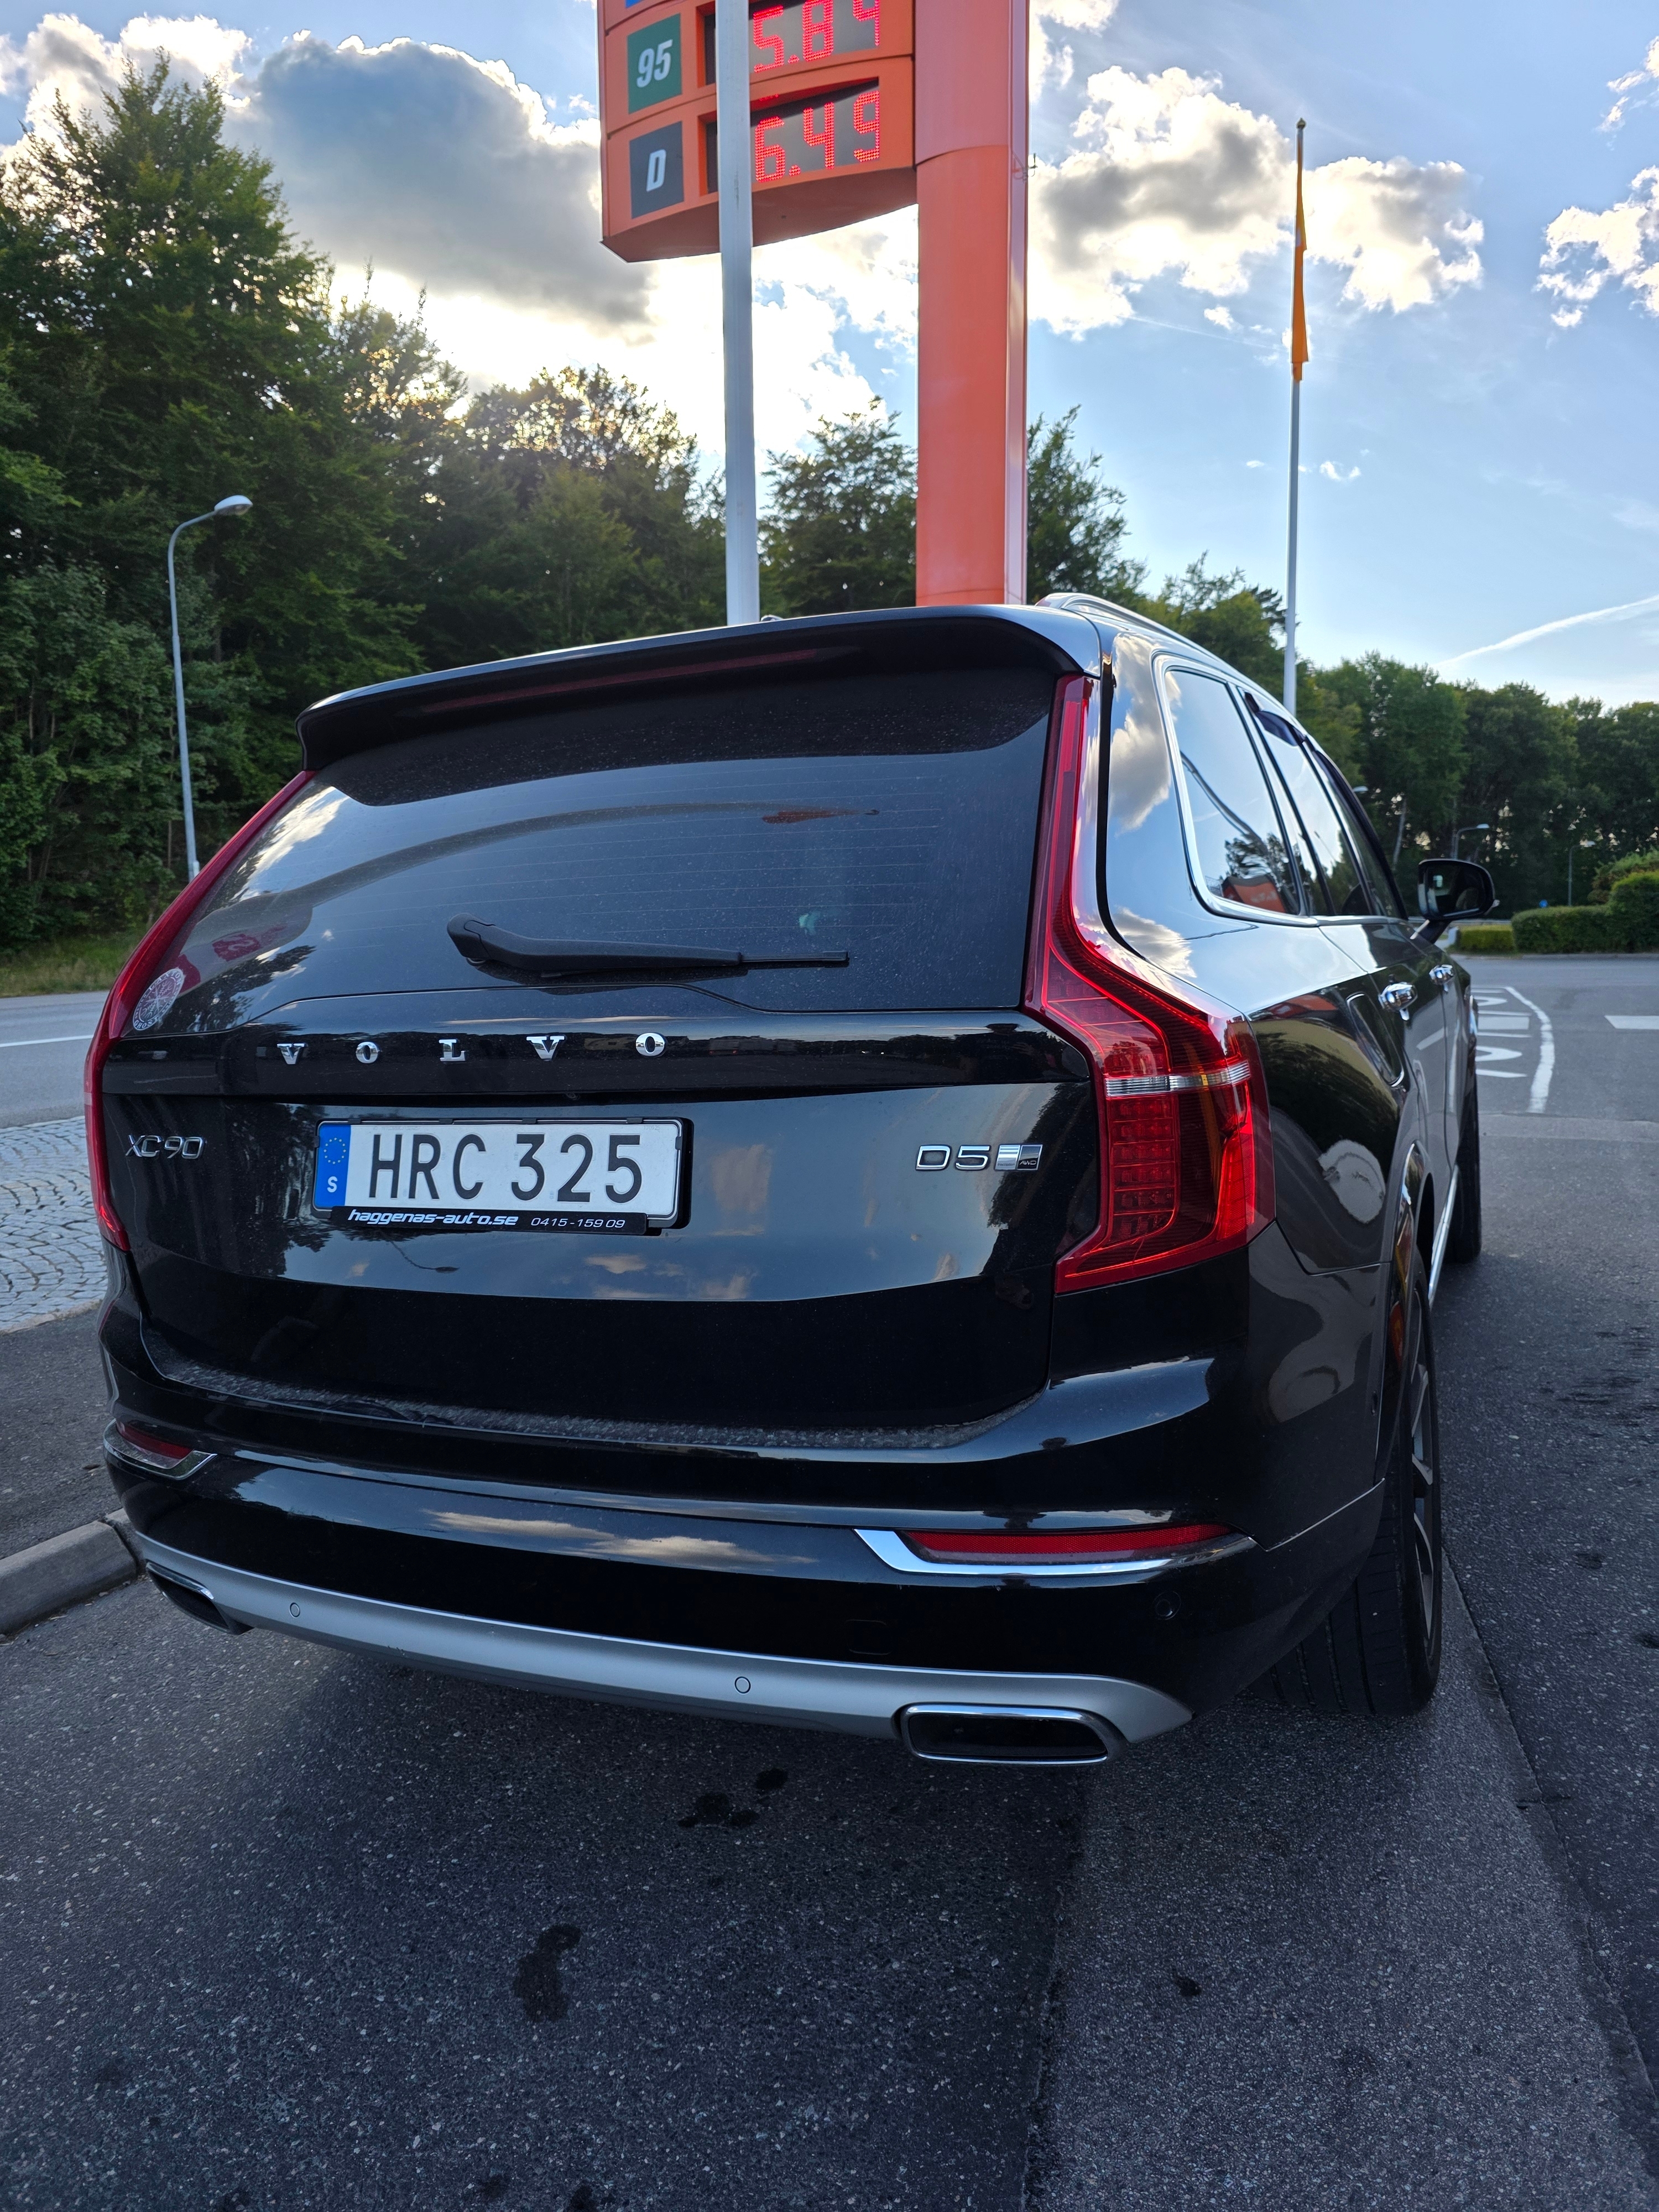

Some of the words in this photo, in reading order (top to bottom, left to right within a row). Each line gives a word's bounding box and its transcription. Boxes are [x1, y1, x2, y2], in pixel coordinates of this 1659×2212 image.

[636, 39, 674, 88] 95
[646, 148, 667, 192] D
[755, 90, 880, 182] 6.49
[277, 1032, 666, 1065] VOLVO
[125, 1135, 205, 1159] XC90
[916, 1145, 990, 1171] D5
[369, 1134, 486, 1200] HRC
[511, 1134, 643, 1203] 325
[327, 1176, 337, 1193] S
[347, 1209, 519, 1227] haggenas-auto.se
